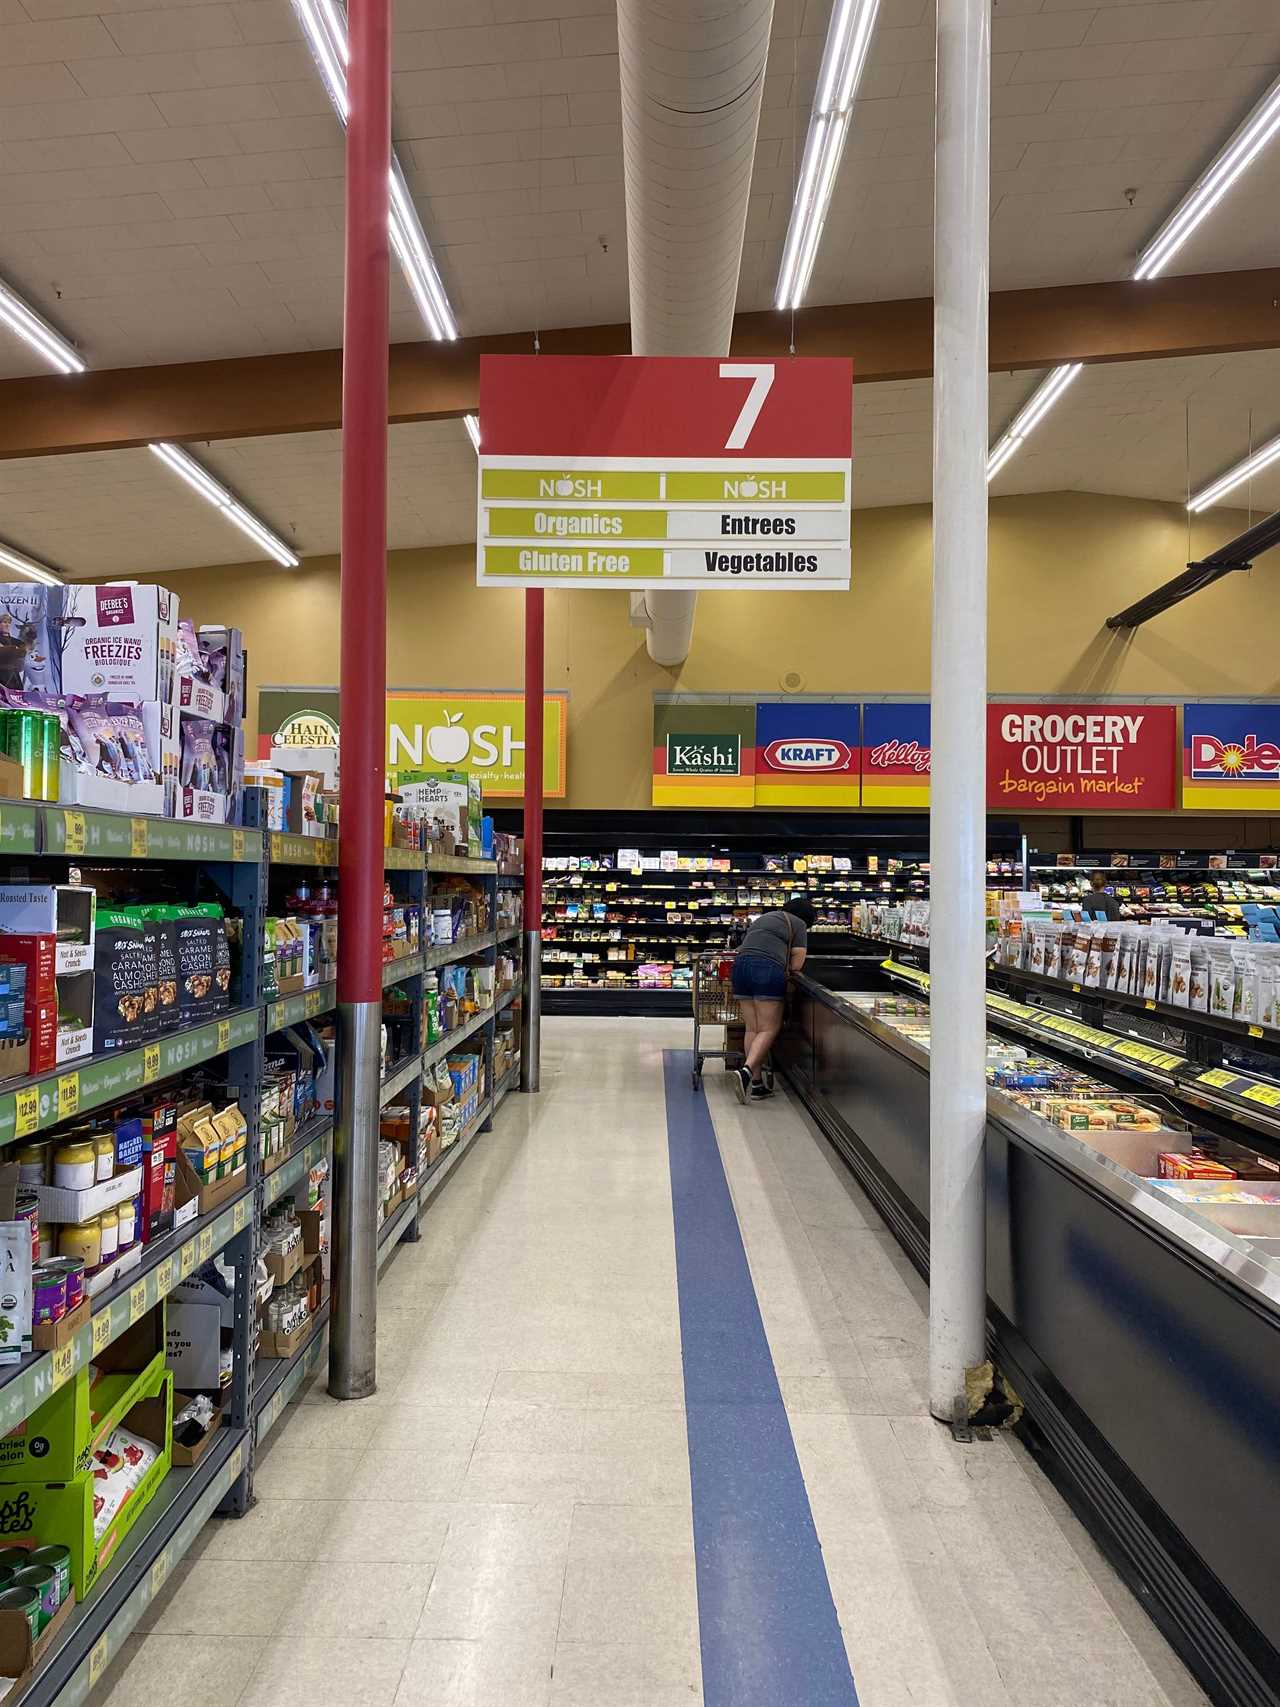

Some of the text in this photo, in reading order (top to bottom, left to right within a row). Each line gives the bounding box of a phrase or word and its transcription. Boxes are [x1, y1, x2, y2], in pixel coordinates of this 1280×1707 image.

[719, 363, 775, 449] 7
[539, 474, 602, 497] NOSH
[723, 475, 787, 498] NOSH
[534, 511, 624, 537] Organics
[720, 514, 796, 536] Entrees
[519, 550, 630, 573] Gluten Free
[704, 551, 818, 575] Vegetables
[0, 595, 29, 604] ROZEN
[100, 597, 129, 610] DEEBEE'S
[85, 636, 142, 646] ORGANIC ICE WAND
[84, 644, 142, 661] FREEZIES
[95, 658, 131, 667] BIOLOGIQUE
[290, 723, 329, 735] HAIN
[1001, 714, 1145, 744] GROCERY
[271, 731, 338, 747] CELESTIA
[673, 745, 735, 766] Kashi
[780, 747, 836, 762] KRAFT
[871, 739, 932, 772] Kellog
[1021, 745, 1123, 774] OUTLET
[1191, 734, 1280, 773] Dole
[999, 768, 1142, 802] bargain market
[418, 795, 449, 803] HEARTS
[111, 960, 143, 971] CARAM
[180, 955, 211, 963] ALMON
[112, 971, 141, 981] ALMO
[118, 1144, 143, 1159] BAKERY
[175, 1341, 191, 1349] you
